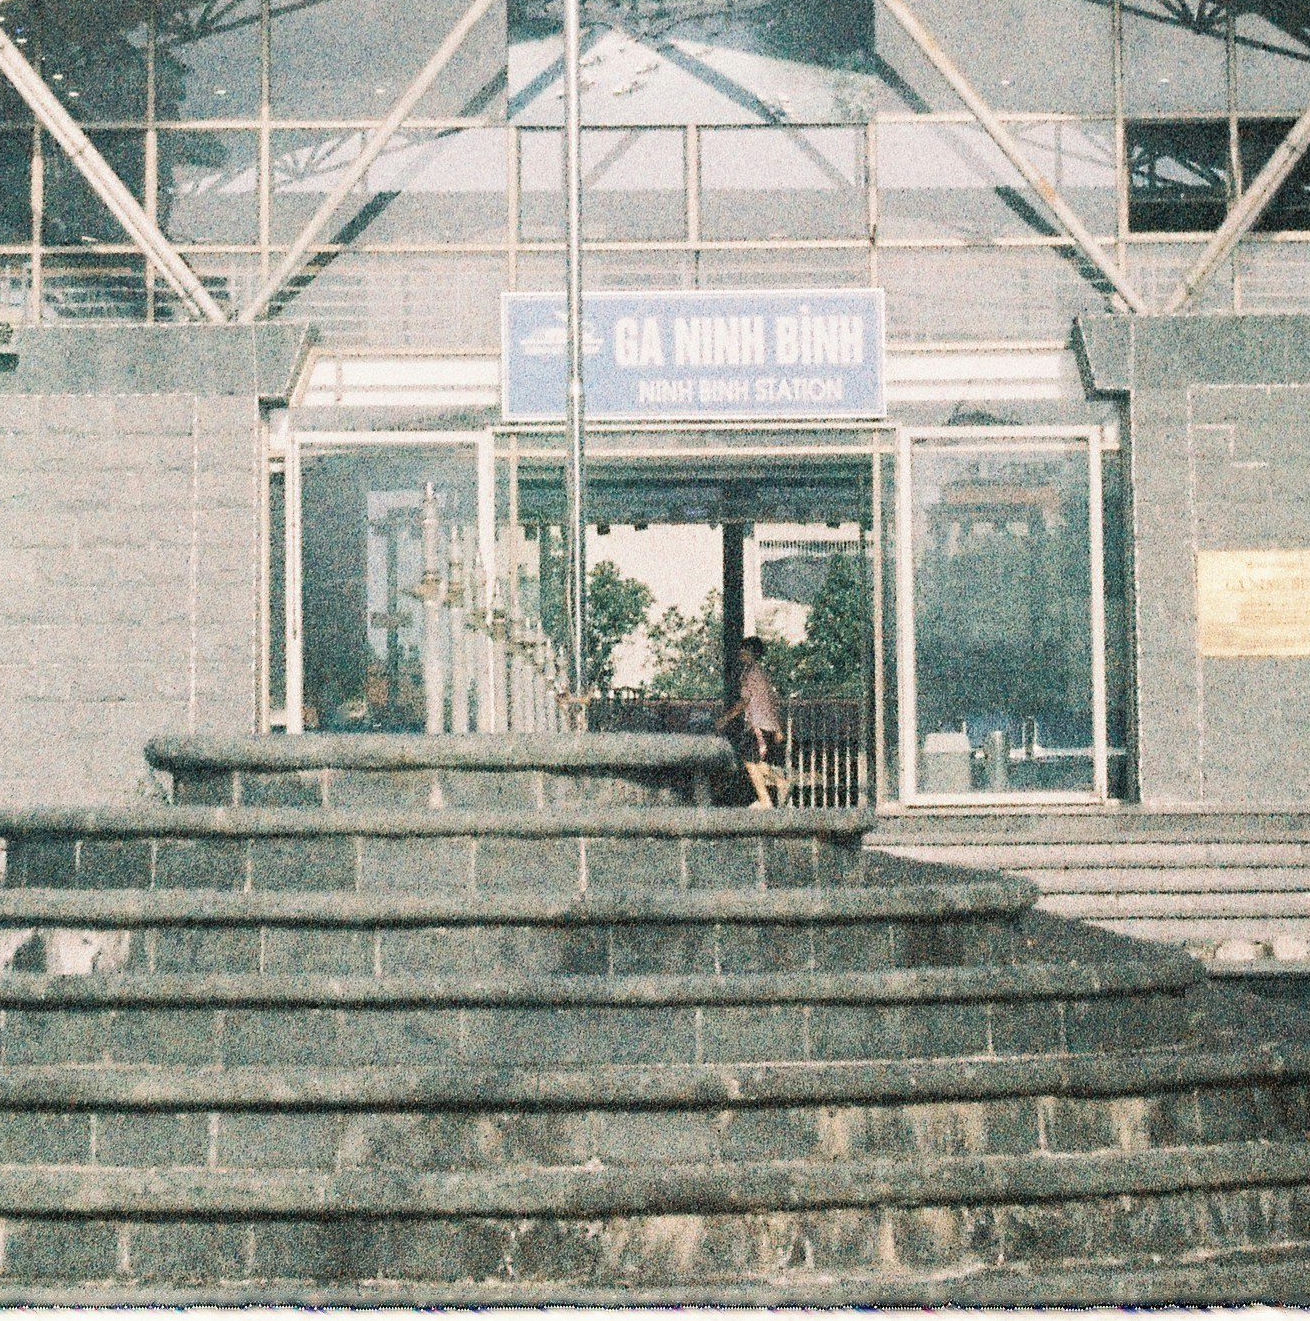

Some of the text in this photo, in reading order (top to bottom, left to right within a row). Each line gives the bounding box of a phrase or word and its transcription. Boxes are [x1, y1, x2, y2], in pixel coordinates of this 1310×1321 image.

[614, 316, 664, 367] GA
[674, 316, 766, 366] NINH
[639, 379, 691, 404] NINH
[755, 377, 843, 402] STATION
